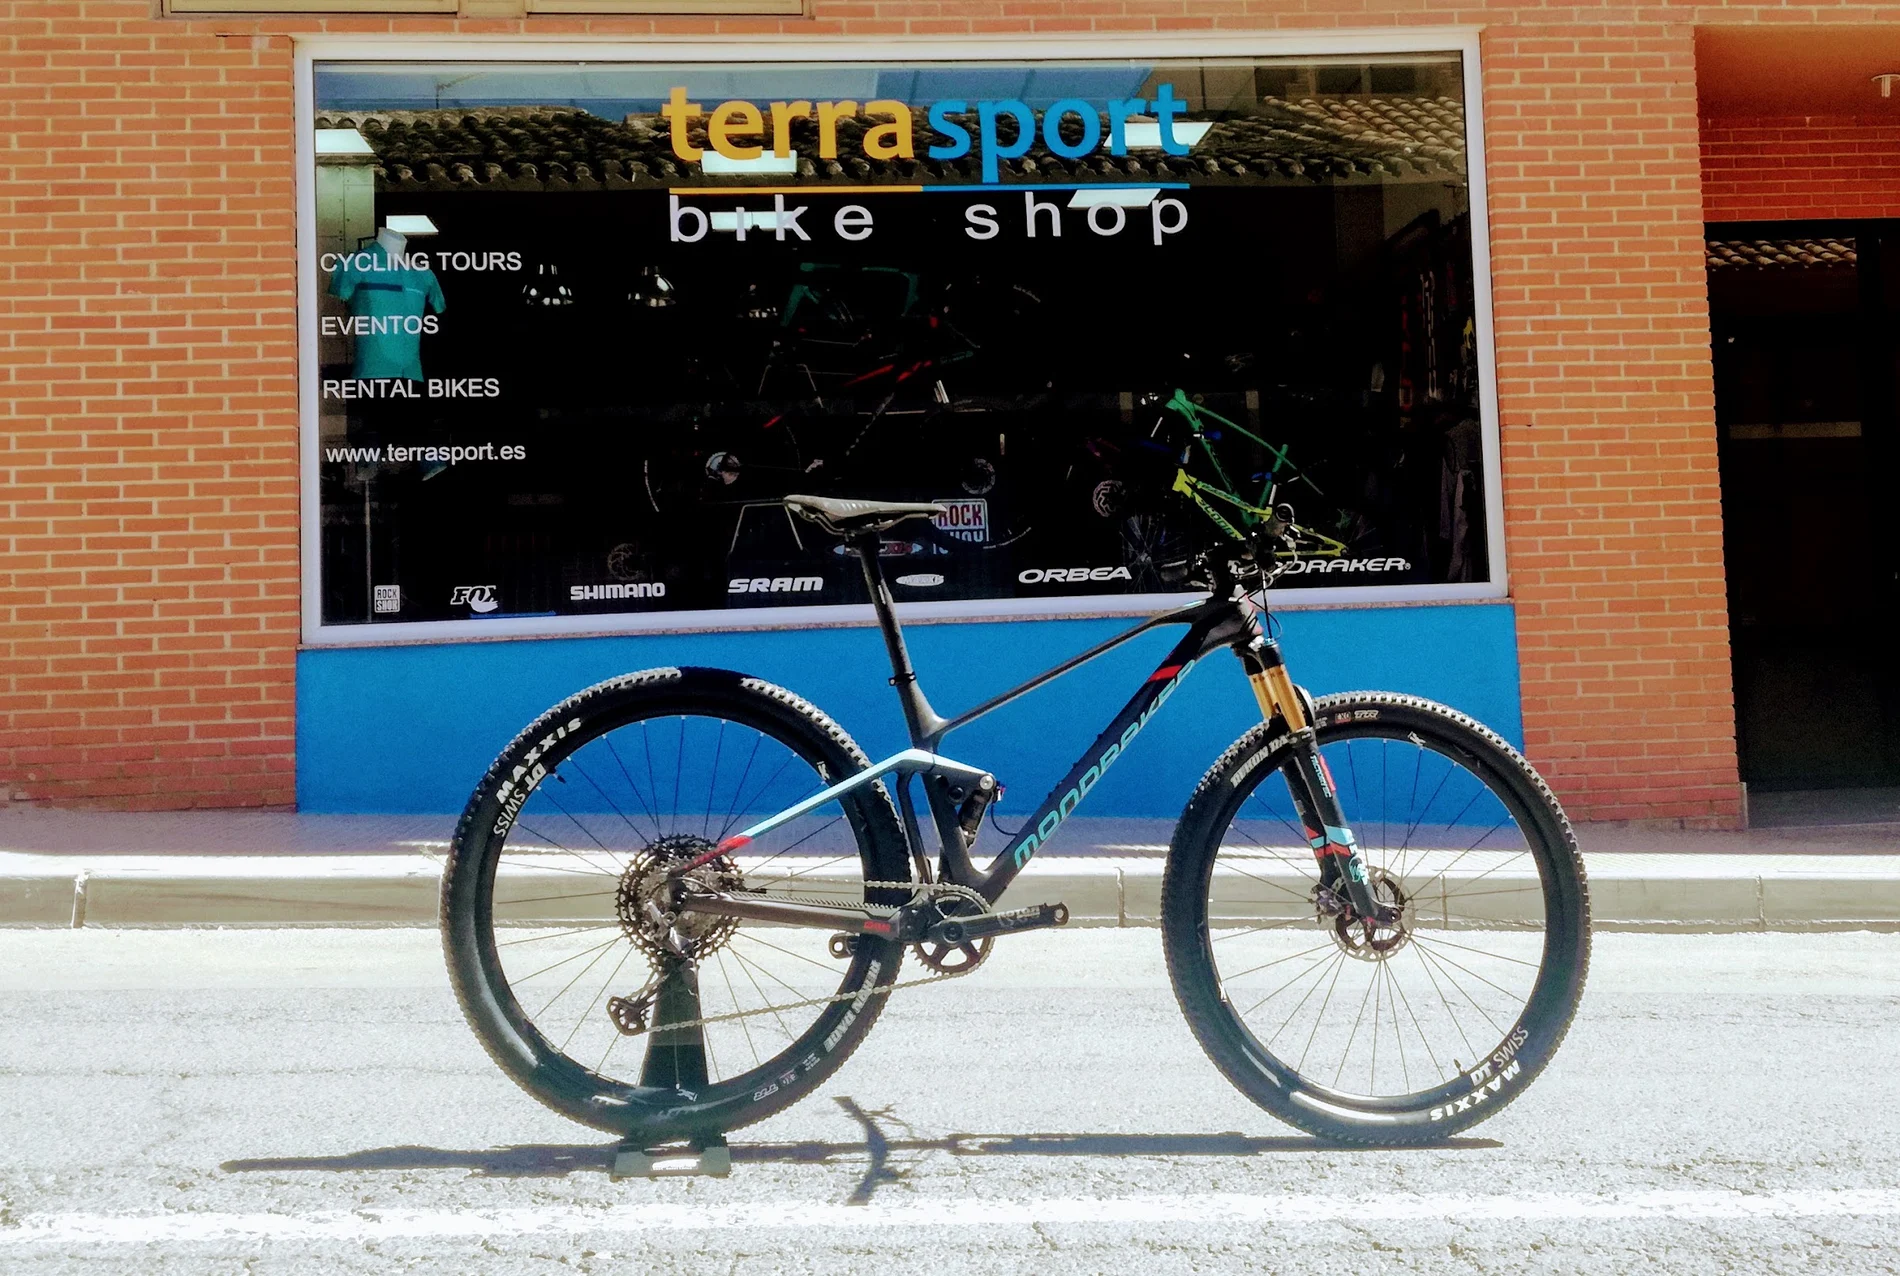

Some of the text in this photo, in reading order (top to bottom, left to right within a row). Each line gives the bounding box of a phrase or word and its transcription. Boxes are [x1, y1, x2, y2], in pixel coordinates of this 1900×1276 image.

[662, 83, 1190, 184] terrasport
[965, 192, 1188, 246] shop
[320, 251, 522, 272] CYCLING TOURS
[321, 315, 439, 336] EVENTOS
[323, 378, 500, 399] RENTAL BIKES
[325, 442, 527, 466] www.terrasport.es
[728, 576, 823, 594] SRAM
[1018, 566, 1132, 584] ORBEA
[376, 588, 397, 599] ROCK
[450, 585, 498, 613] FOX
[570, 582, 666, 601] SHIMANO
[496, 717, 581, 804] MAXXIS
[1014, 659, 1196, 869] MONDRAKER
[493, 762, 547, 837] DT SWISS
[1470, 1026, 1529, 1087] DT SWISS
[1429, 1060, 1521, 1121] MAXXIS
